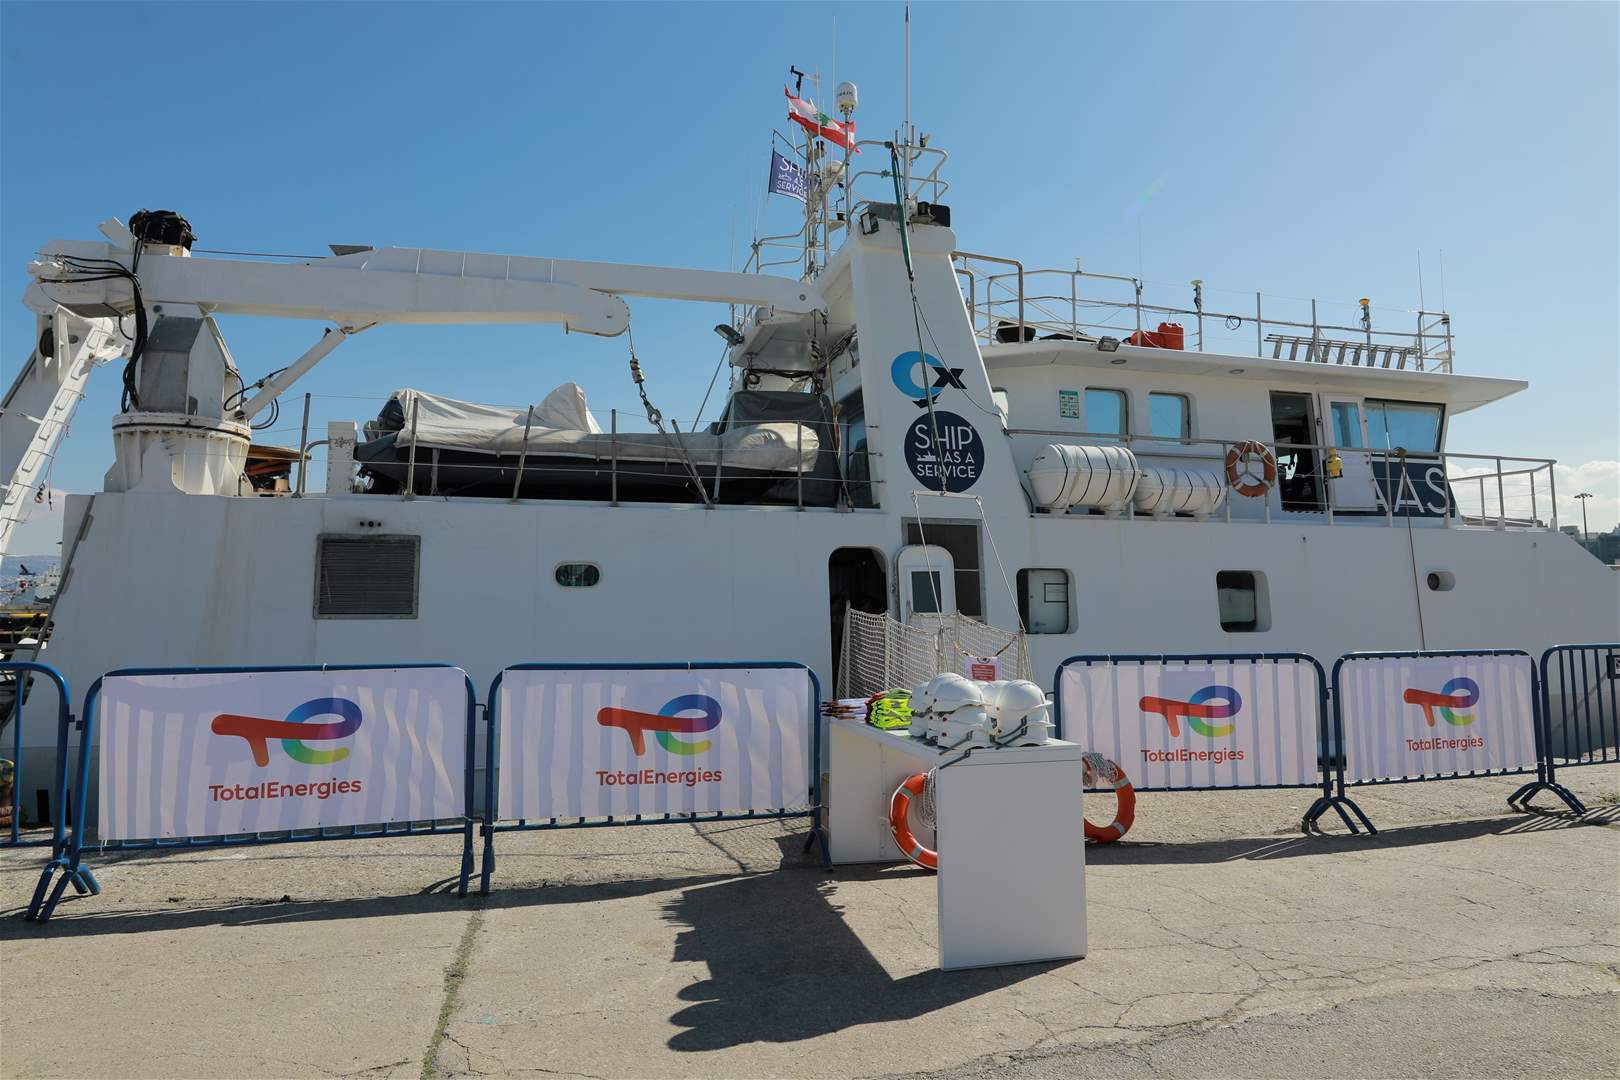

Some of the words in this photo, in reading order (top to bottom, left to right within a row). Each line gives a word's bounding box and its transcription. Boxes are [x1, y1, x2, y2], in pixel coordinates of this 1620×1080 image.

[914, 424, 973, 450] SHIP
[943, 451, 961, 463] AS
[965, 452, 975, 464] A
[917, 464, 976, 478] SERVICE
[1406, 736, 1484, 751] TotalEnergies
[1140, 748, 1244, 764] TotalEnergies
[595, 768, 722, 787] TotalEnergies
[208, 777, 362, 801] TotalEnergies
